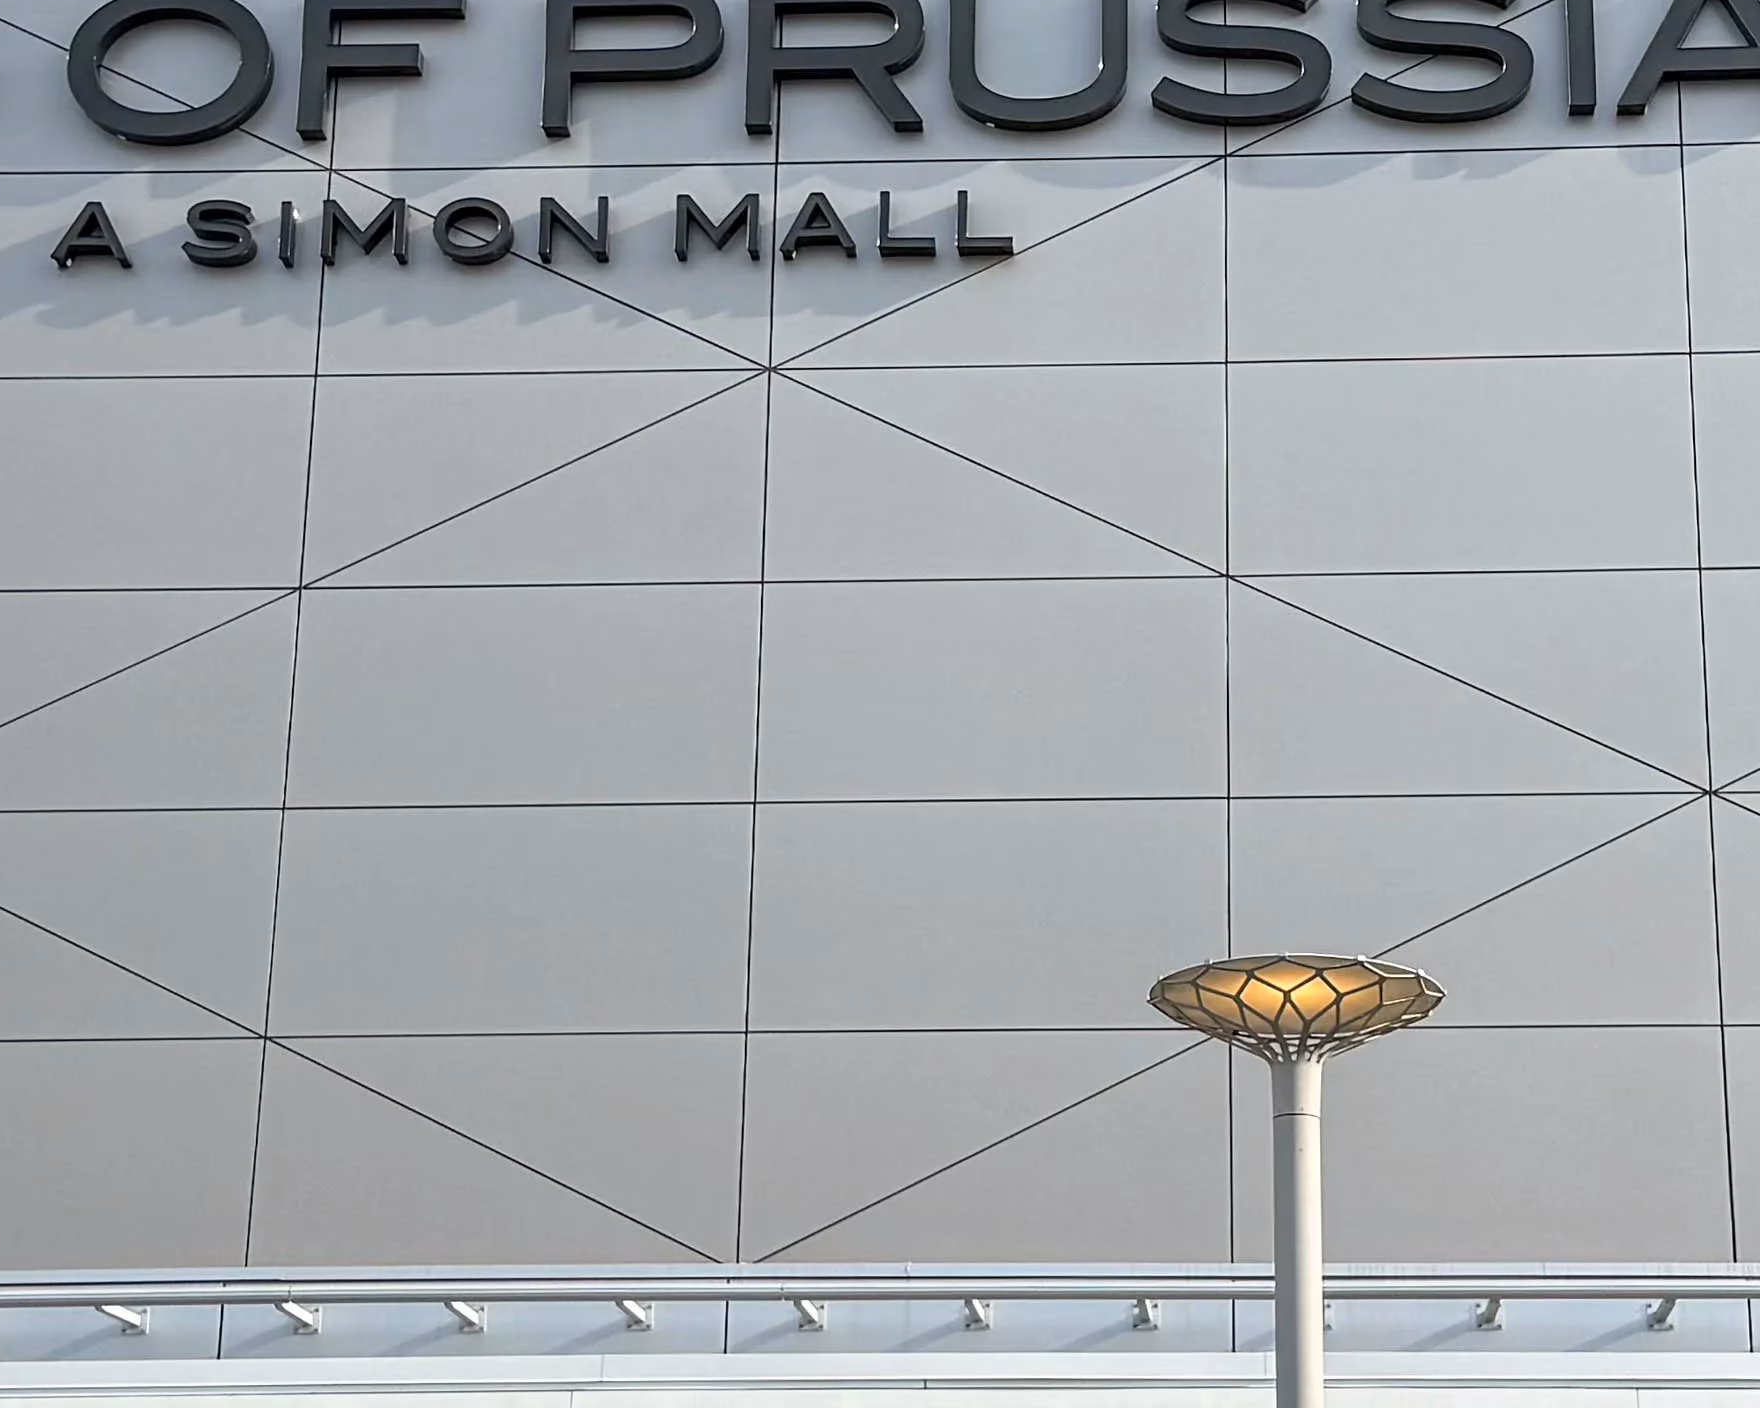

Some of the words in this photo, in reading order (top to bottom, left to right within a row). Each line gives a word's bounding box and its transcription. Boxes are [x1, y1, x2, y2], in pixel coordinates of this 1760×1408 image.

[51, 201, 133, 270] A
[181, 195, 611, 269] SIMON
[673, 189, 1016, 264] MALL
